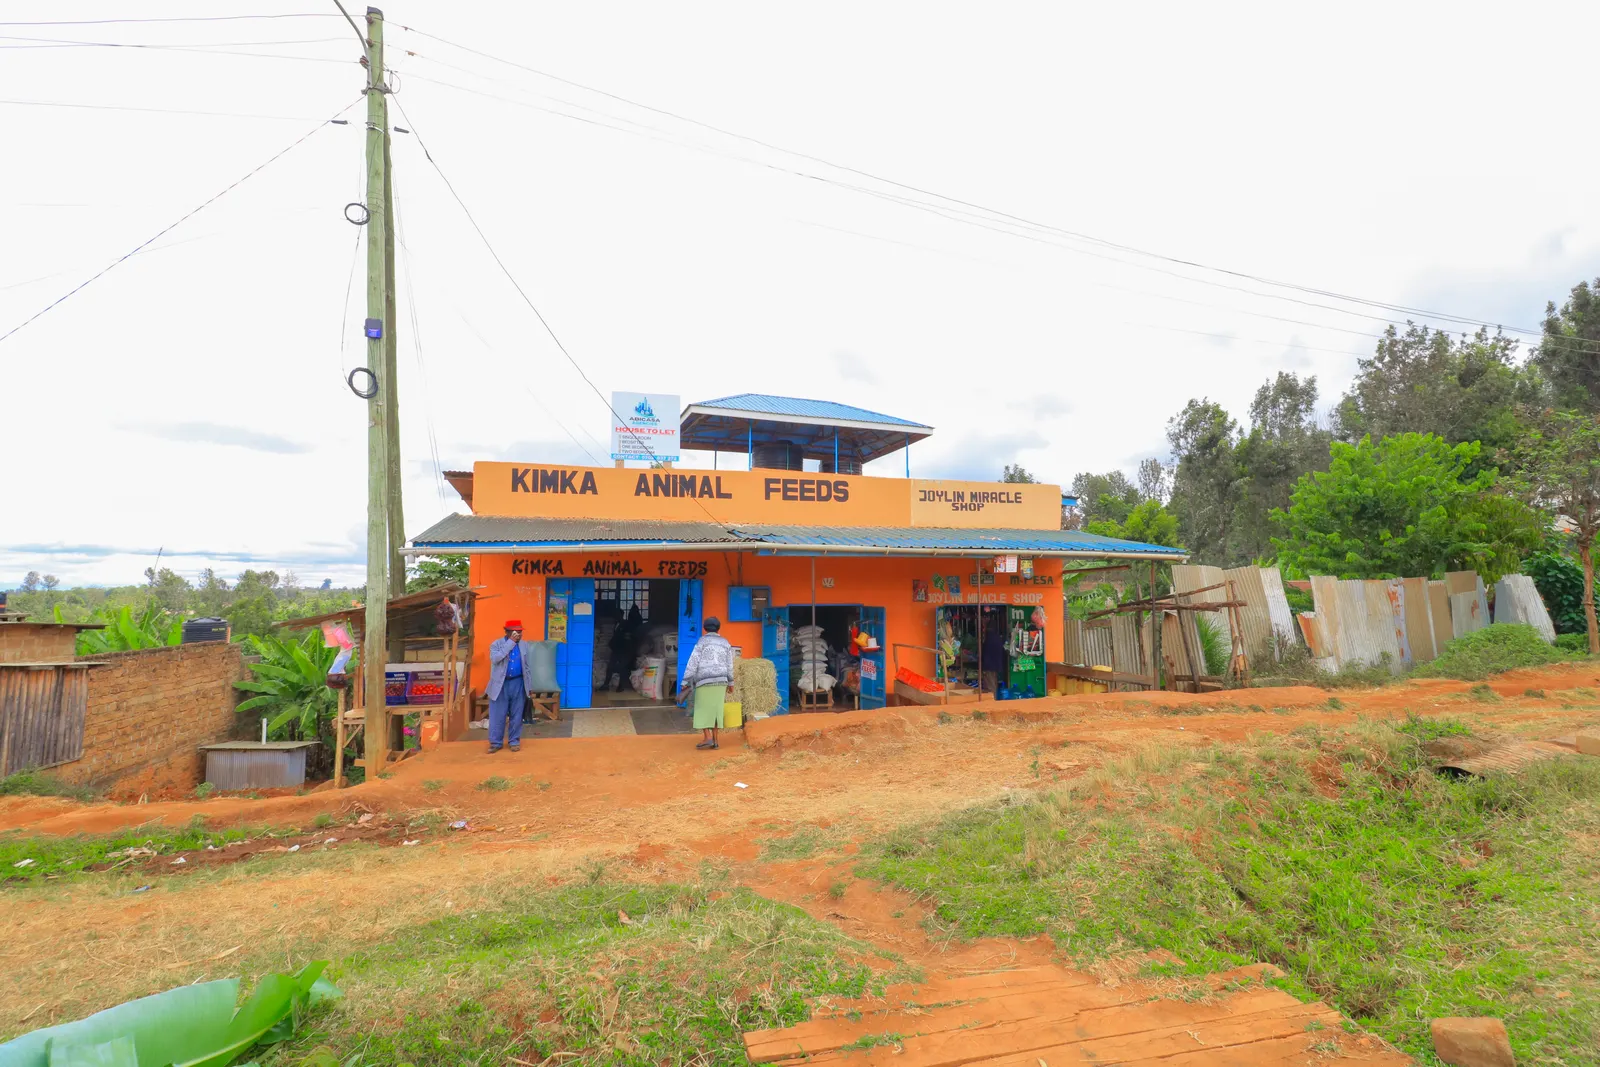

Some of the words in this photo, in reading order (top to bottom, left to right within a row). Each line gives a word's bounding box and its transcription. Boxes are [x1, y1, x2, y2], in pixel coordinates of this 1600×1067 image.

[511, 468, 598, 495] KIMKA
[634, 473, 732, 499] ANIMAL
[764, 478, 849, 502] FEEDS
[919, 489, 965, 503] JOYLIN
[970, 491, 1022, 504] MIRACLE
[951, 502, 985, 512] SHOP
[658, 560, 708, 576] FEEDS
[967, 593, 1006, 603] MIRACLE
[1013, 593, 1043, 603] SHOP
